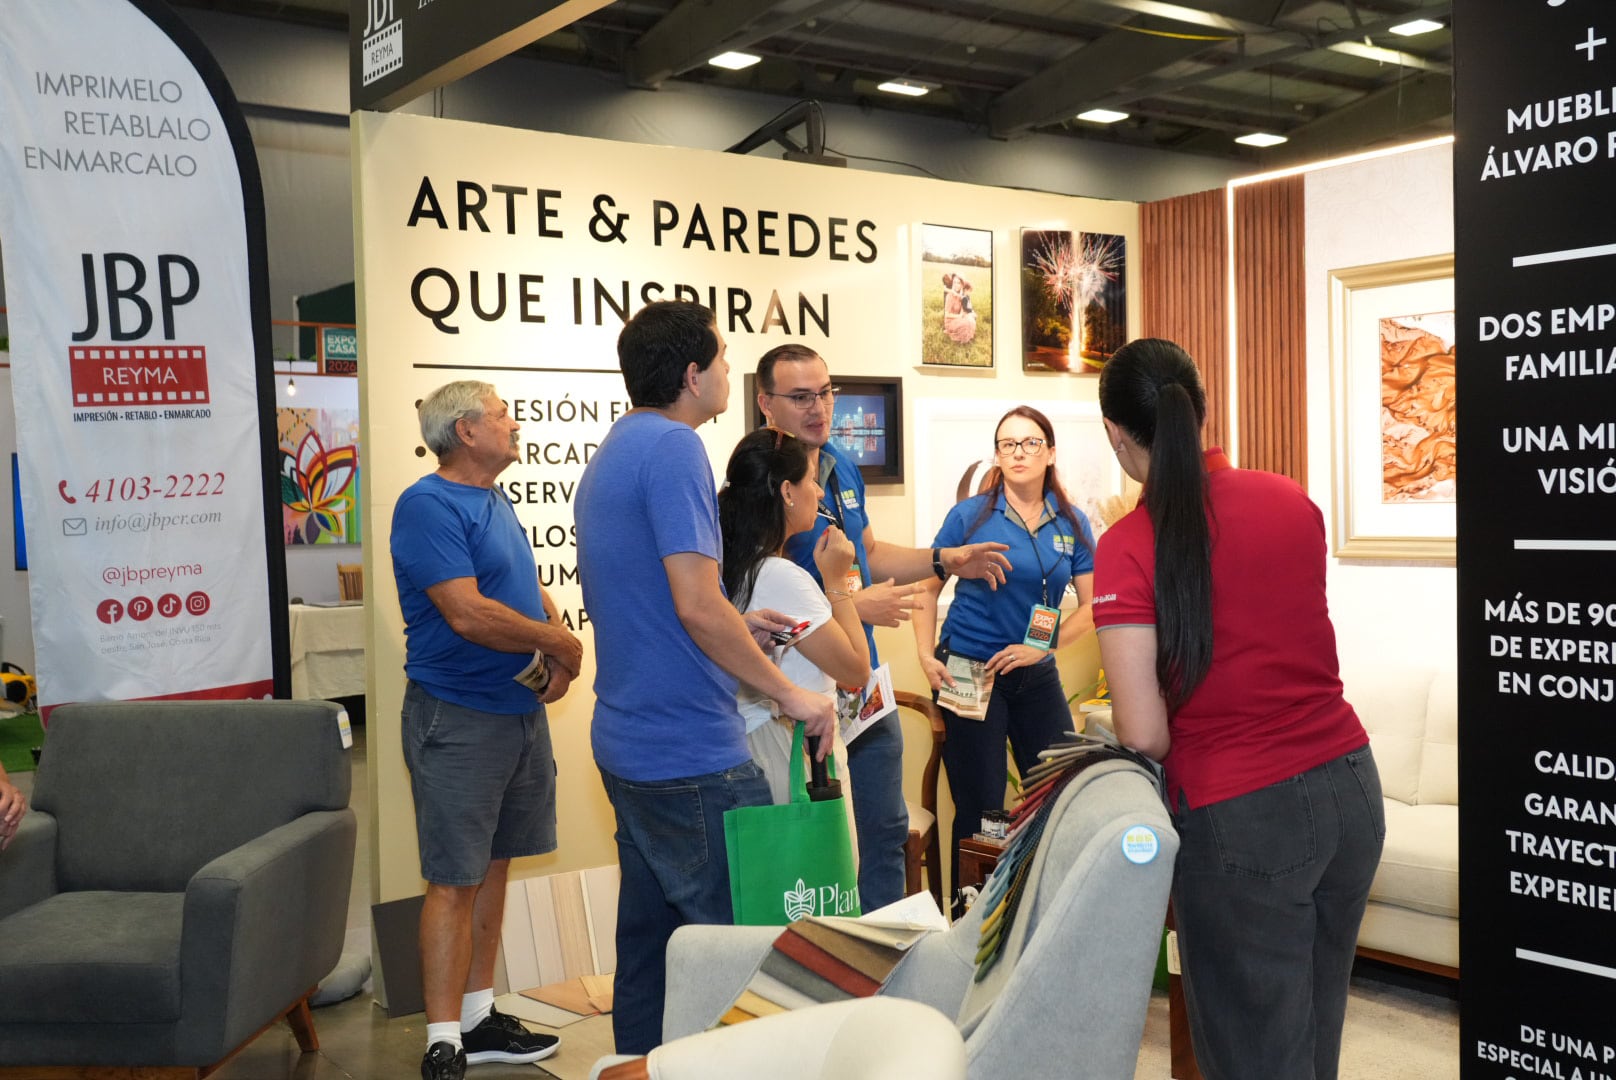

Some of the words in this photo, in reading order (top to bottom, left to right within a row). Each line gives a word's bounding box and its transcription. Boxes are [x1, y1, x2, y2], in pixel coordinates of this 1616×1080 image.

[371, 43, 394, 65] REYMA
[36, 72, 182, 103] IMPRIMELO
[64, 111, 211, 141] RETABLALO
[24, 146, 197, 177] ENMARCALO
[1480, 135, 1598, 181] ÁLVARO
[407, 175, 563, 239] ARTE
[588, 193, 630, 244] &
[653, 199, 878, 264] PAREDES
[72, 252, 200, 342] JBP
[410, 267, 546, 335] QUE
[1479, 311, 1542, 342] DOS
[1551, 304, 1616, 335] EMP
[327, 334, 356, 345] EXPO
[327, 344, 356, 354] CASA
[103, 367, 178, 385] REYMA
[329, 360, 356, 371] 2026
[74, 411, 118, 422] IMPRESIÓN
[125, 410, 158, 421] RETABLO
[164, 409, 211, 419] ENMARCADO
[501, 392, 598, 422] ESIÓN
[1502, 425, 1569, 453] UNA
[1578, 422, 1616, 450] MI
[85, 472, 225, 503] 4103-2222
[1537, 457, 1616, 495] VISIÓ
[95, 511, 222, 535] info@jbpcr.com
[102, 563, 203, 587] @jbpreyma
[1485, 591, 1539, 623] MÁS
[1546, 601, 1581, 625] DE
[1029, 630, 1049, 640] 2026
[1490, 635, 1523, 658] DE
[1498, 671, 1531, 696] EN
[1538, 674, 1614, 702] CONJ
[1534, 750, 1616, 780] CALID
[1524, 792, 1616, 826] GARAN
[1505, 829, 1616, 869] TRAYECT
[1510, 870, 1616, 912] EXPERIE
[1520, 1024, 1546, 1048] DE
[1552, 1032, 1598, 1061] UNA
[1603, 1045, 1616, 1064] P
[1477, 1040, 1566, 1080] ESPECIAL
[1570, 1066, 1584, 1080] A
